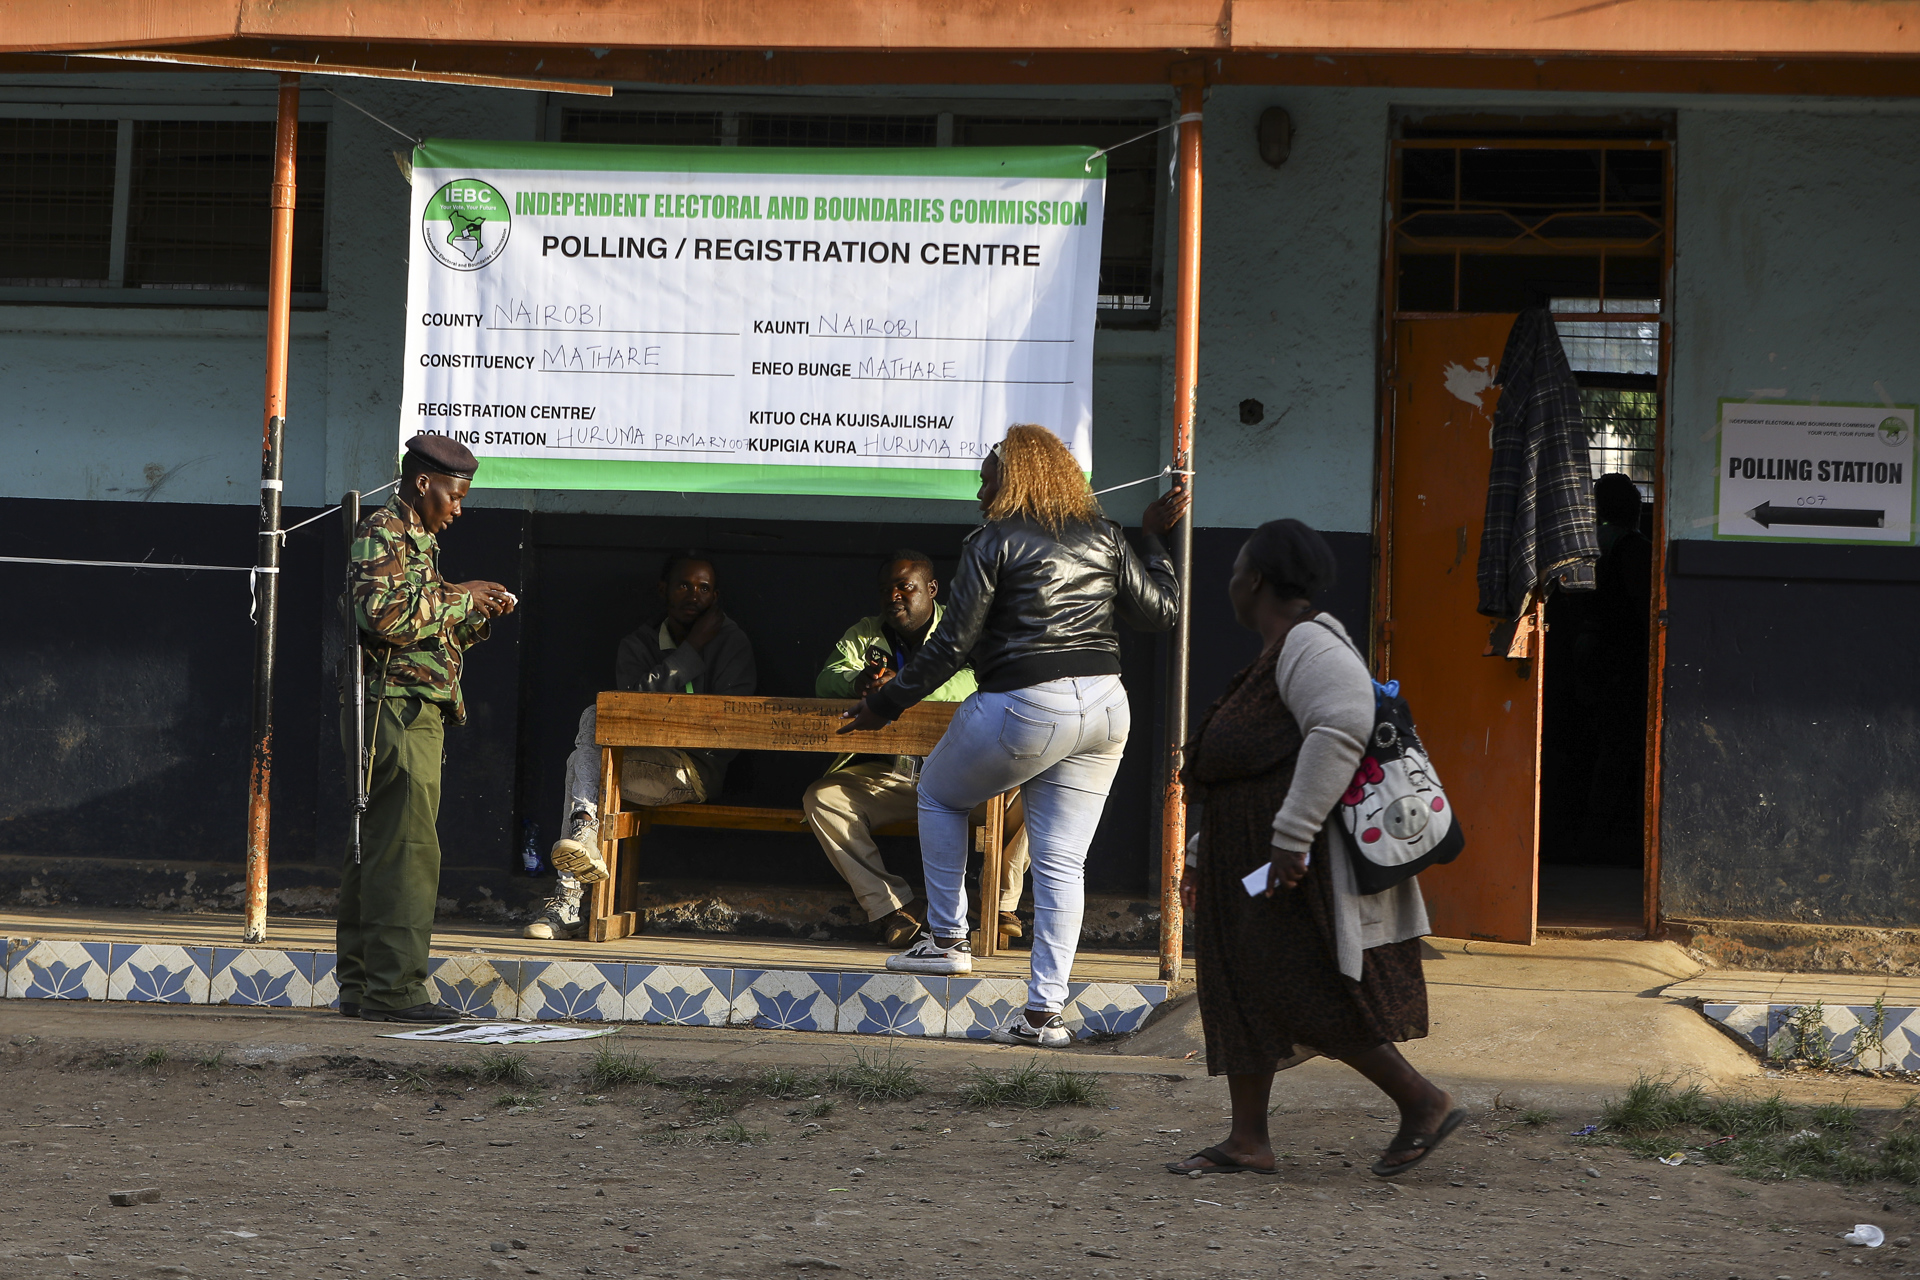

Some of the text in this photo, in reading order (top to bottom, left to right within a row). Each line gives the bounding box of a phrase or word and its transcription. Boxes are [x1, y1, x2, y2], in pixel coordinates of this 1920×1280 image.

[445, 188, 491, 203] IEBC
[516, 191, 1087, 226] INDEPENDENT ELECTORAL AND BOUNDARIES COMMISSION
[542, 235, 667, 260] POLLING
[694, 238, 911, 264] REGISTRATION
[920, 243, 1041, 266] CENTRE
[422, 314, 483, 328] COUNTY
[494, 298, 602, 329] NAIROBI
[753, 320, 810, 335] KAUNTI
[818, 314, 918, 338] NAIROBI
[420, 354, 535, 370] CONSTITUENCY
[542, 344, 662, 370] MATHARE
[752, 362, 852, 377] ENEO BUNGE
[858, 357, 957, 380] MATHARE
[417, 402, 596, 420] REGISTRATION CENTRE/
[749, 411, 954, 429] KITUO CHA KUJISAJILISHA/
[484, 431, 546, 445] STATION
[556, 426, 646, 448] HURUMA
[749, 438, 856, 454] KUPIGIA KURA
[864, 433, 950, 458] HURUMA
[1729, 457, 1902, 484] POLLING STATION
[1797, 496, 1828, 506] 007
